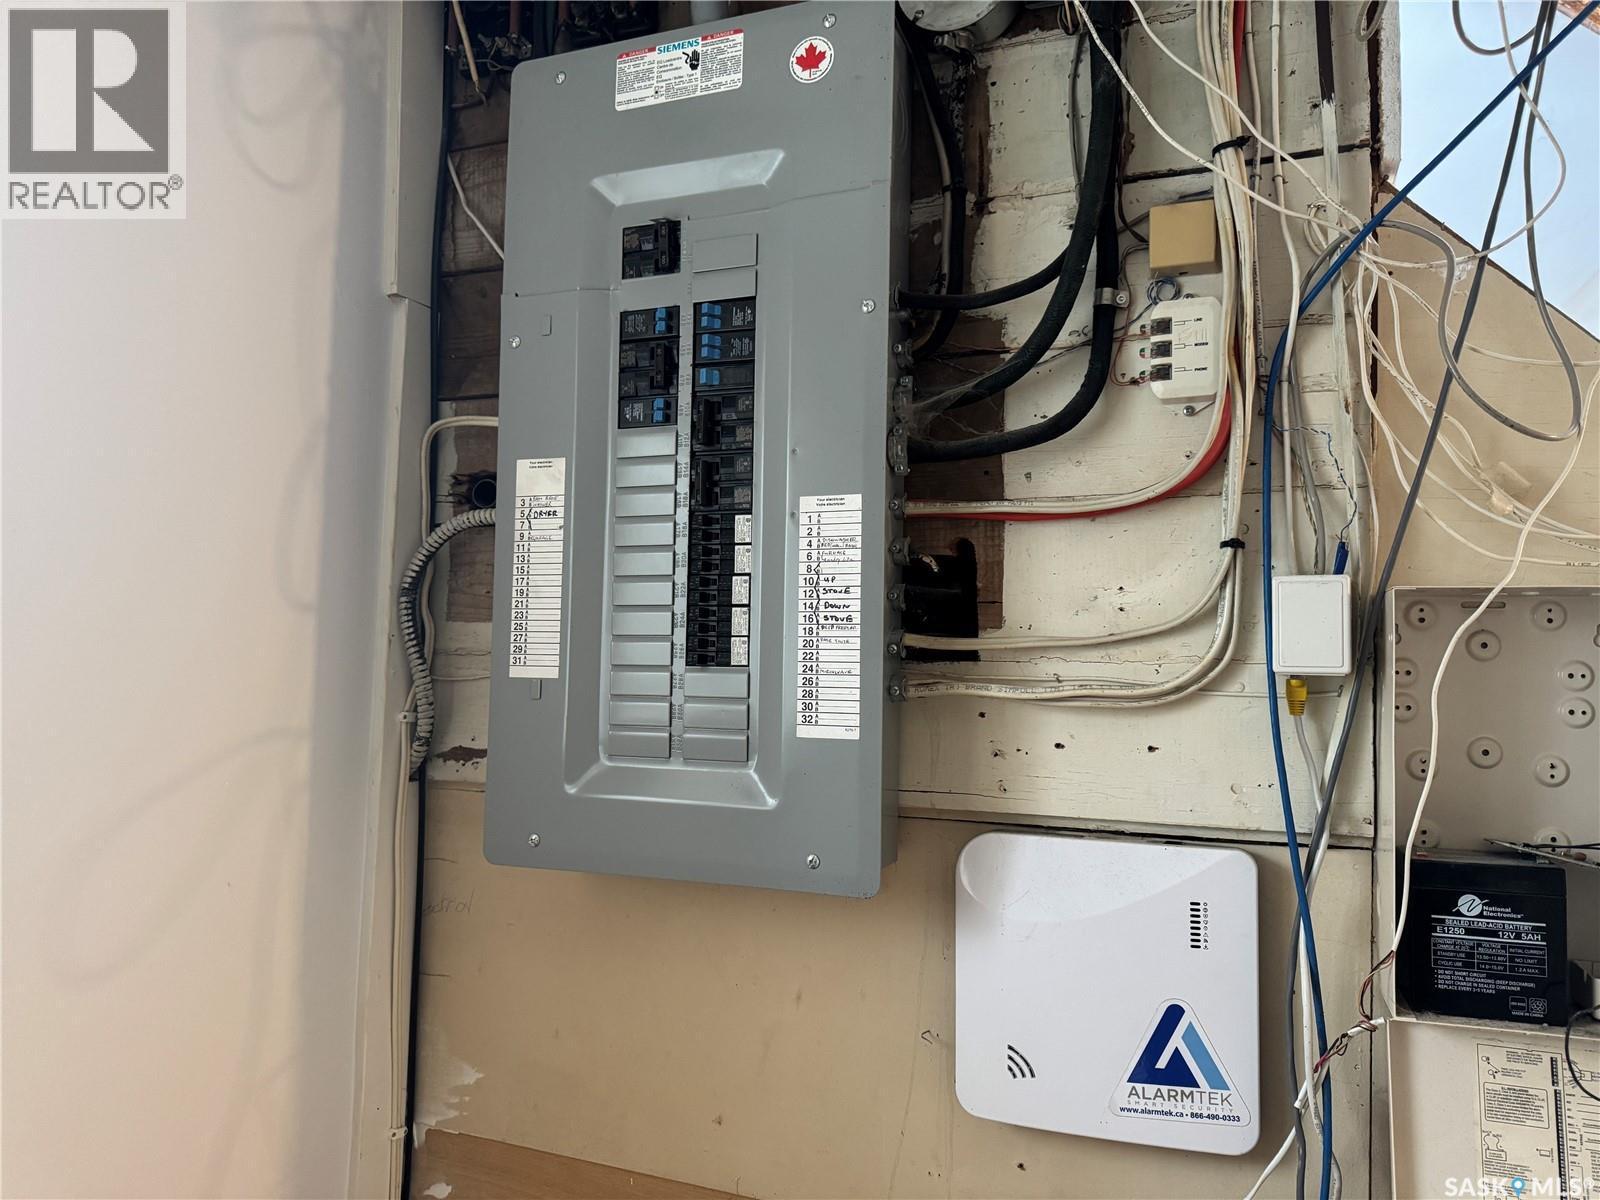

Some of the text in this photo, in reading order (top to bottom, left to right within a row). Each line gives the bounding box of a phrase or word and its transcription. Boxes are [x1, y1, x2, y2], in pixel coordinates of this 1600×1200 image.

[657, 39, 700, 54] SIEMENS
[534, 510, 558, 519] DRYER
[808, 515, 812, 523] 1
[807, 527, 812, 536] 2
[807, 540, 812, 548] 4
[807, 552, 812, 560] 6
[806, 564, 812, 573] 8
[803, 577, 814, 585] 10
[803, 589, 814, 598] 12
[803, 602, 814, 610] 14
[803, 614, 814, 623] 16
[803, 627, 813, 635] 18
[802, 639, 814, 648] 20
[803, 652, 814, 660] 22
[802, 664, 813, 673] 24
[802, 677, 813, 686] 26
[802, 689, 813, 698] 28
[802, 702, 813, 711] 30
[802, 714, 813, 723] 32
[1470, 921, 1503, 929] LEAD-ACID
[1437, 926, 1465, 934] E1250
[1128, 1086, 1232, 1107] ALARMTEK
[1174, 1104, 1234, 1113] SECURITY
[1120, 1106, 1240, 1122] www.alarmtek.ca 866-490-0333
